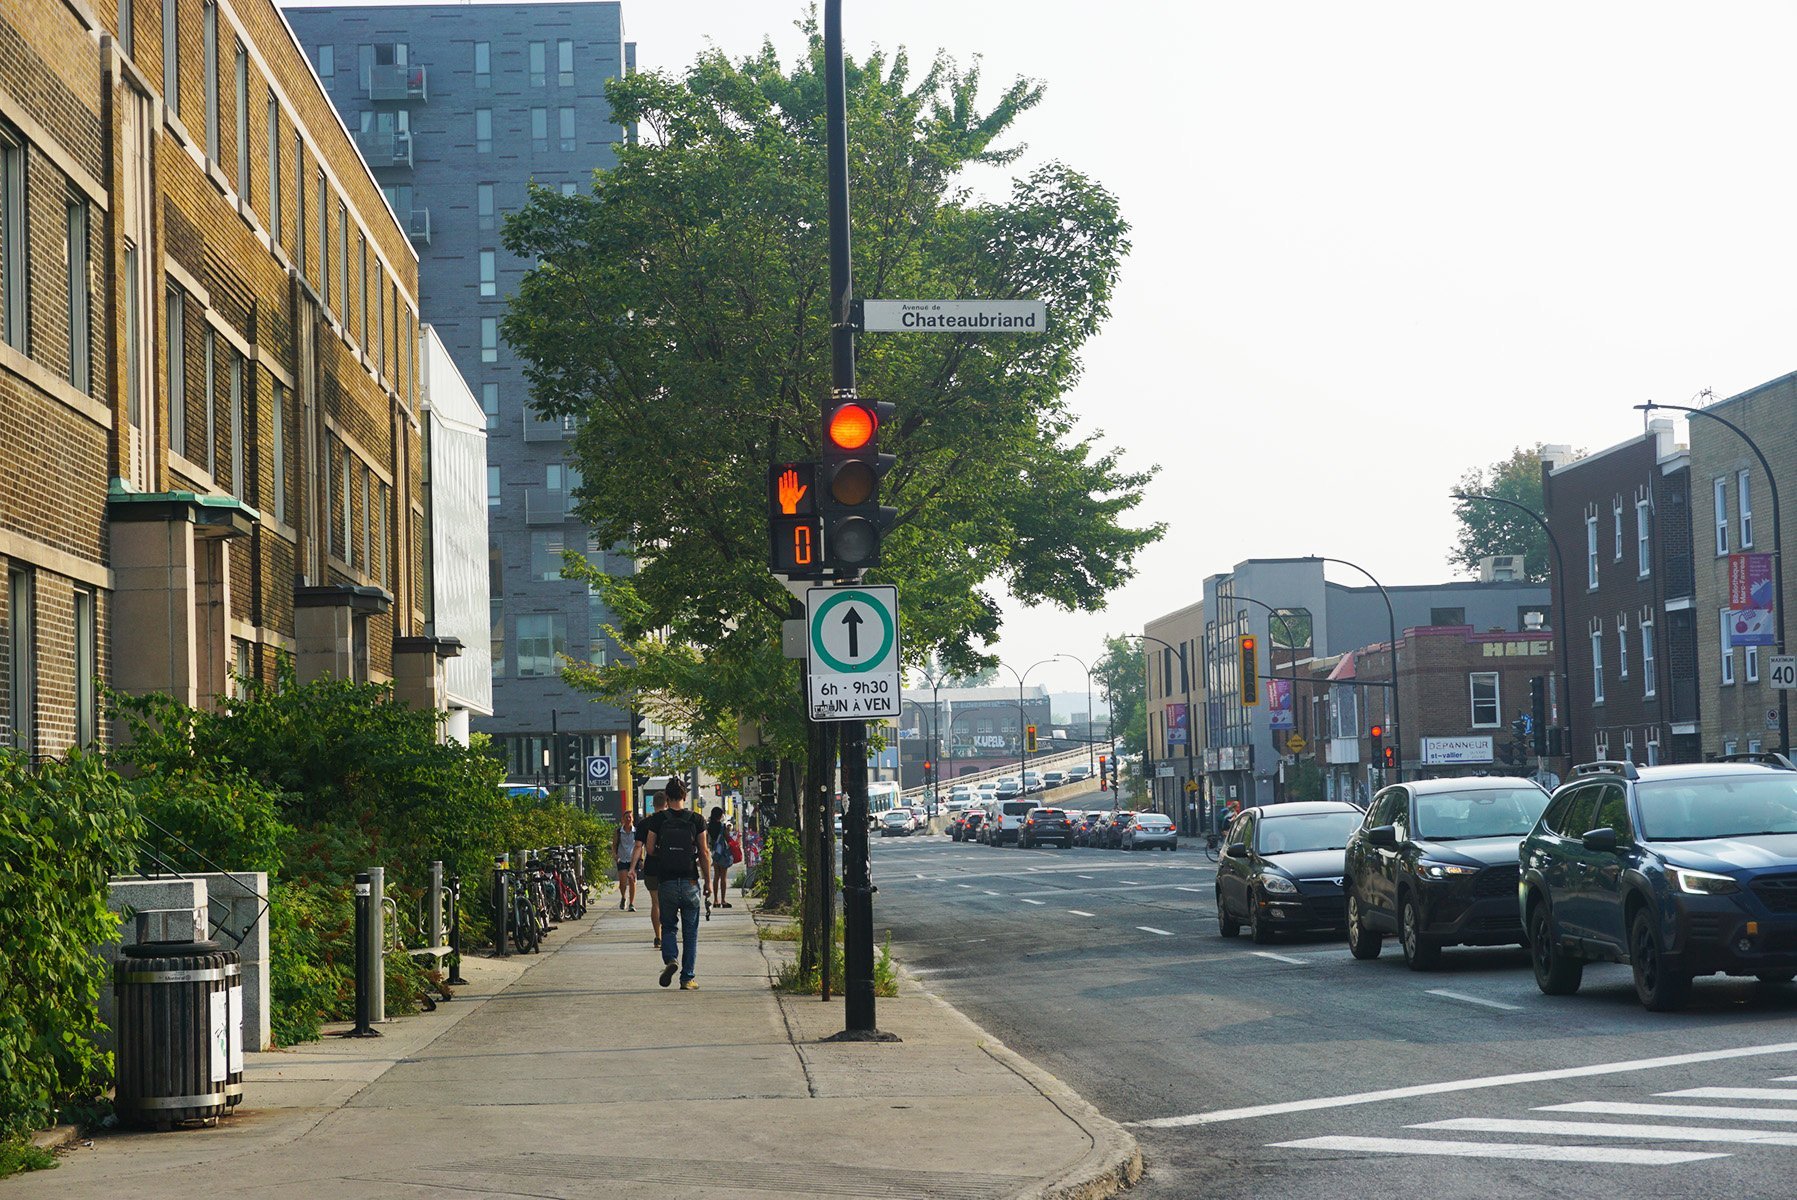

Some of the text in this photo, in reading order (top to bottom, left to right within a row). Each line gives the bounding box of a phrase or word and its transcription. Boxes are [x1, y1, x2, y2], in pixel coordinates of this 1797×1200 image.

[902, 312, 1036, 328] Chateaubriand
[795, 526, 811, 565] 0
[1772, 666, 1795, 684] 40
[821, 682, 838, 696] 6h
[853, 680, 889, 694] 9h30
[852, 699, 861, 711] À
[864, 697, 891, 711] VEN
[747, 777, 754, 785] P
